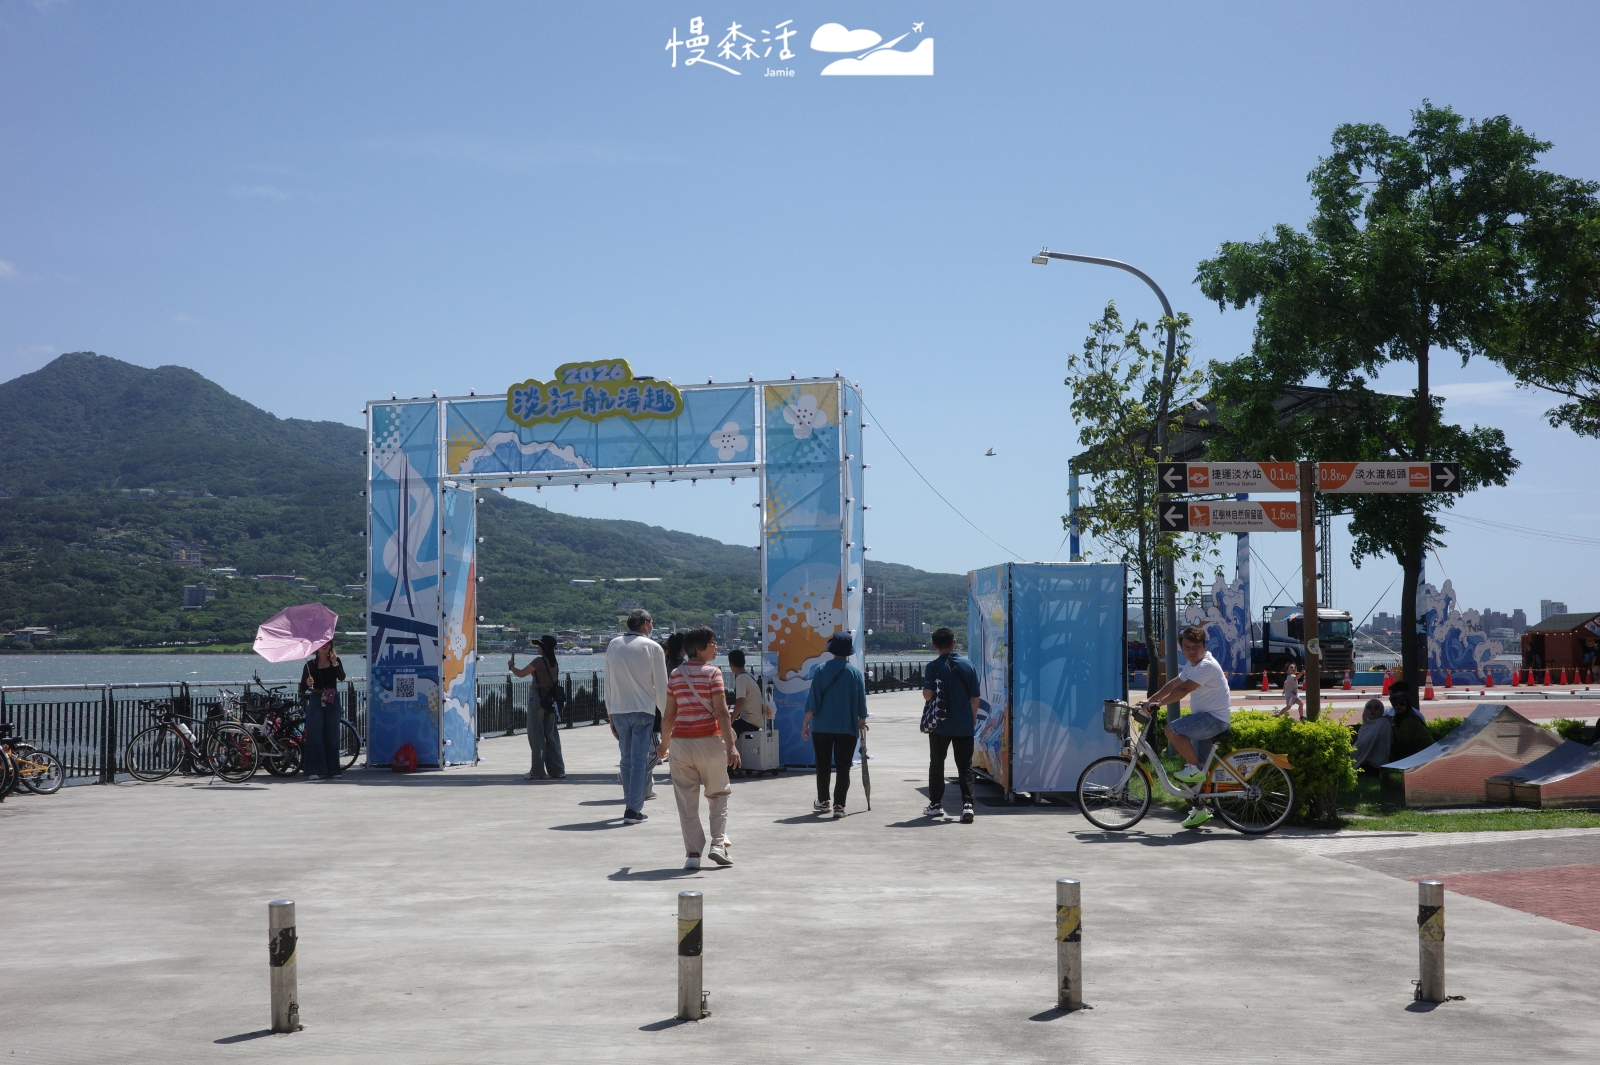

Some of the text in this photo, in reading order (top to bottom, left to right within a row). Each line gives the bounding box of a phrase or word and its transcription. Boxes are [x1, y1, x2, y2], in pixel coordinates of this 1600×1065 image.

[562, 364, 626, 385] 2026
[513, 385, 676, 421] 淡江航海趣
[1212, 469, 1261, 479] 捷運淡水站
[1270, 468, 1296, 481] 0.1Km
[1321, 468, 1347, 481] 0.8Km
[1356, 469, 1406, 479] 淡水渡船頭
[1212, 509, 1263, 520] 紅樹林自然保留區
[1271, 508, 1297, 520] 1.6Km
